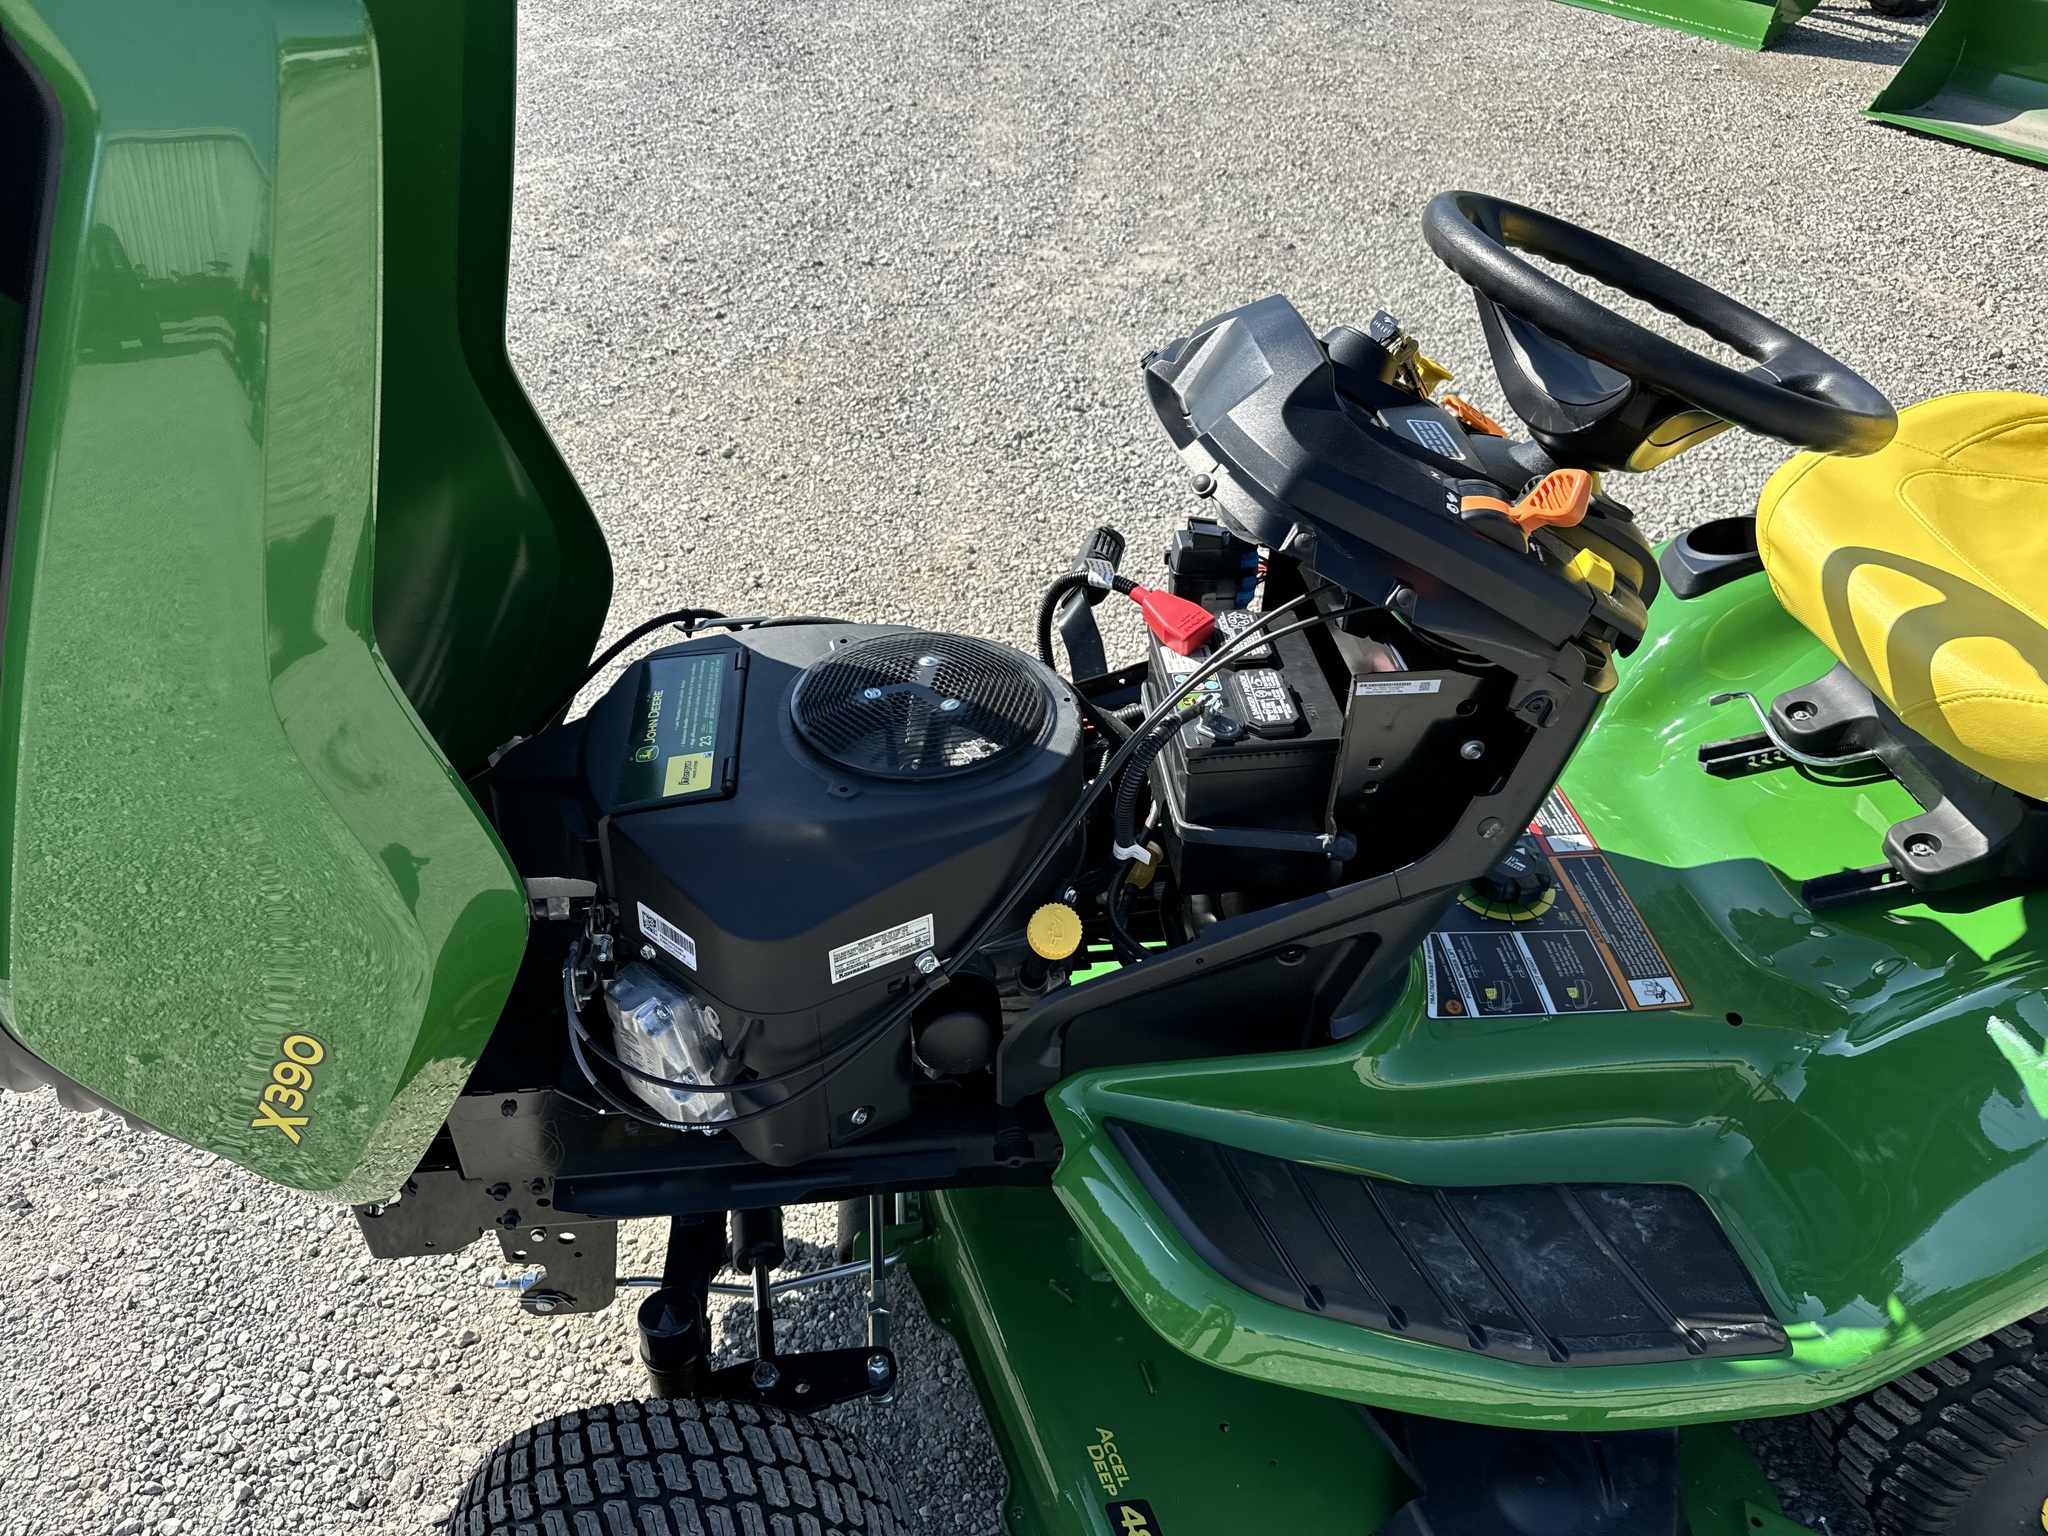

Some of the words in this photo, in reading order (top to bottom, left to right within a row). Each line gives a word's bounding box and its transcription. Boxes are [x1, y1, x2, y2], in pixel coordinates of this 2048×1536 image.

[1239, 675, 1251, 692] POISON
[648, 690, 663, 719] DEERE
[1247, 696, 1260, 715] DANGER
[644, 717, 658, 743] JOHN
[699, 735, 712, 747] 23
[679, 761, 692, 785] iTorque
[1582, 911, 1601, 938] WARNING
[839, 963, 870, 979] Kawasaki
[1453, 960, 1464, 978] MOWER
[1527, 957, 1538, 974] HEIGHT
[1460, 979, 1471, 998] POWER
[251, 1034, 324, 1145] X390
[1096, 1427, 1131, 1488] ACCEL
[1086, 1444, 1118, 1497] DEEP
